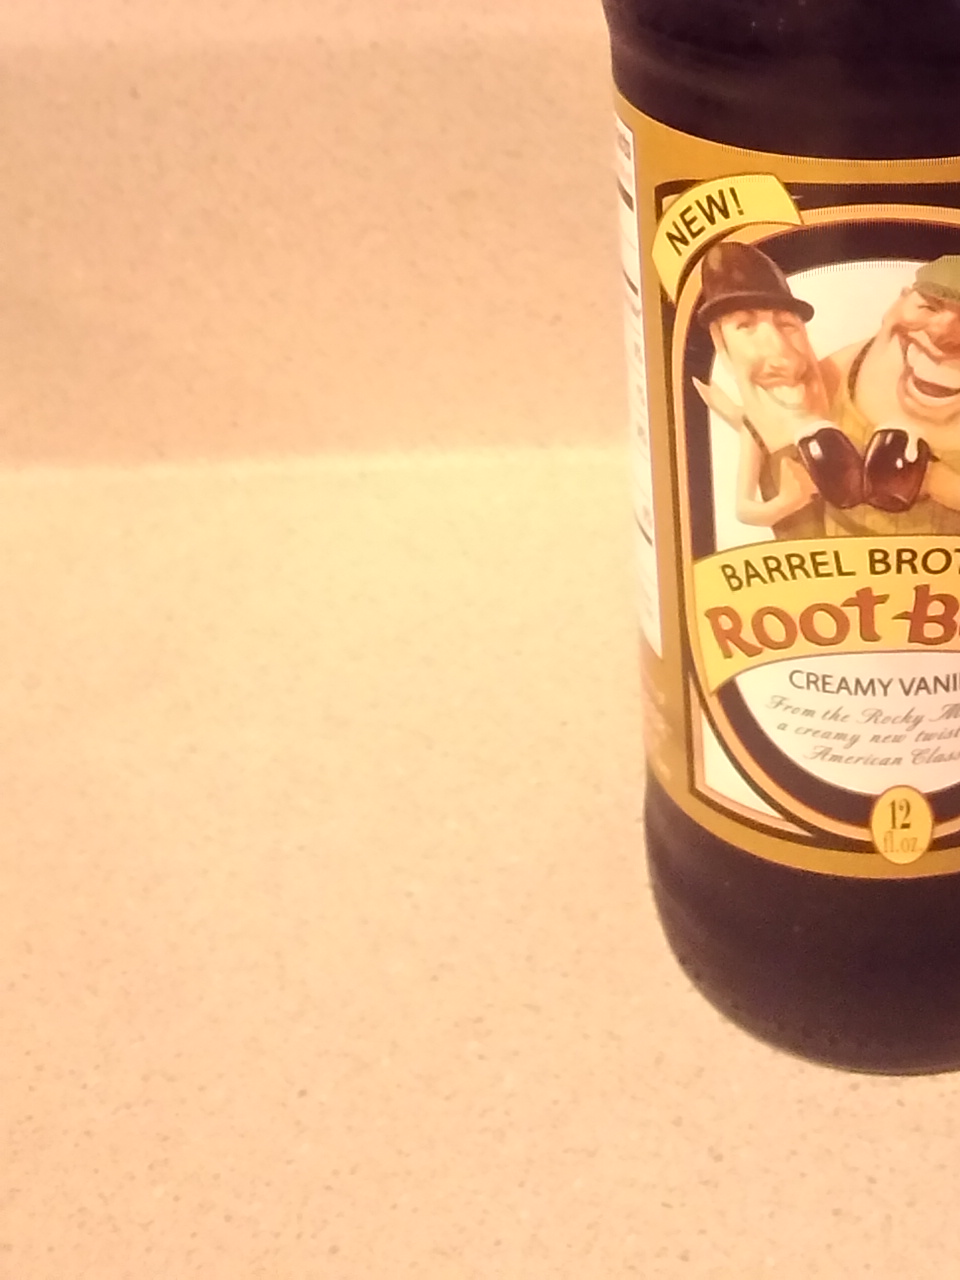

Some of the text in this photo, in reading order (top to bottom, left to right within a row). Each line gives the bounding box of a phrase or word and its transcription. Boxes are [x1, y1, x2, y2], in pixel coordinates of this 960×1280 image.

[665, 186, 745, 257] NEW!
[721, 550, 856, 592] BARREL
[788, 669, 894, 697] CREAMY
[765, 694, 817, 718] From
[820, 705, 851, 723] the
[856, 707, 926, 732] Rocky
[776, 722, 789, 731] a
[794, 726, 861, 750] creamy
[868, 734, 908, 744] new
[802, 745, 904, 767] American
[889, 798, 911, 830] 12
